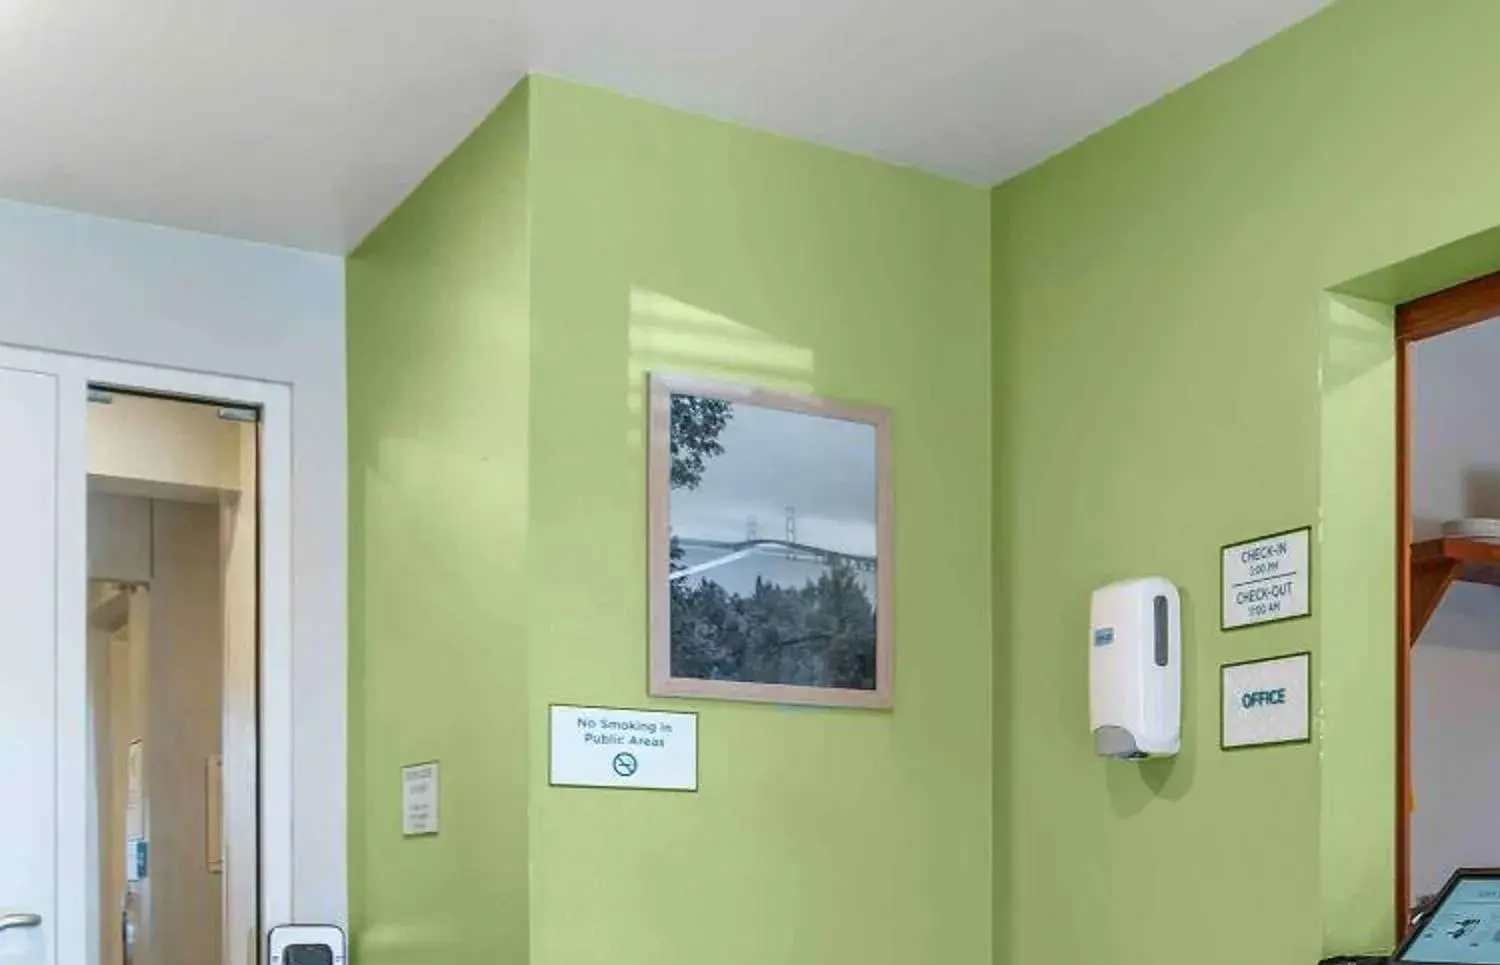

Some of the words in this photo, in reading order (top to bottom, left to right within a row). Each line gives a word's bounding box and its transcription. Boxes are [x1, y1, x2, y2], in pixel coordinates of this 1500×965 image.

[1241, 541, 1287, 564] CHECK-IN
[1236, 581, 1293, 605] CHECK-OUT
[1241, 687, 1286, 709] OFFICE
[576, 718, 597, 729] No
[599, 719, 657, 734] Smoking
[584, 733, 625, 745] Public
[628, 735, 665, 748] Areas
